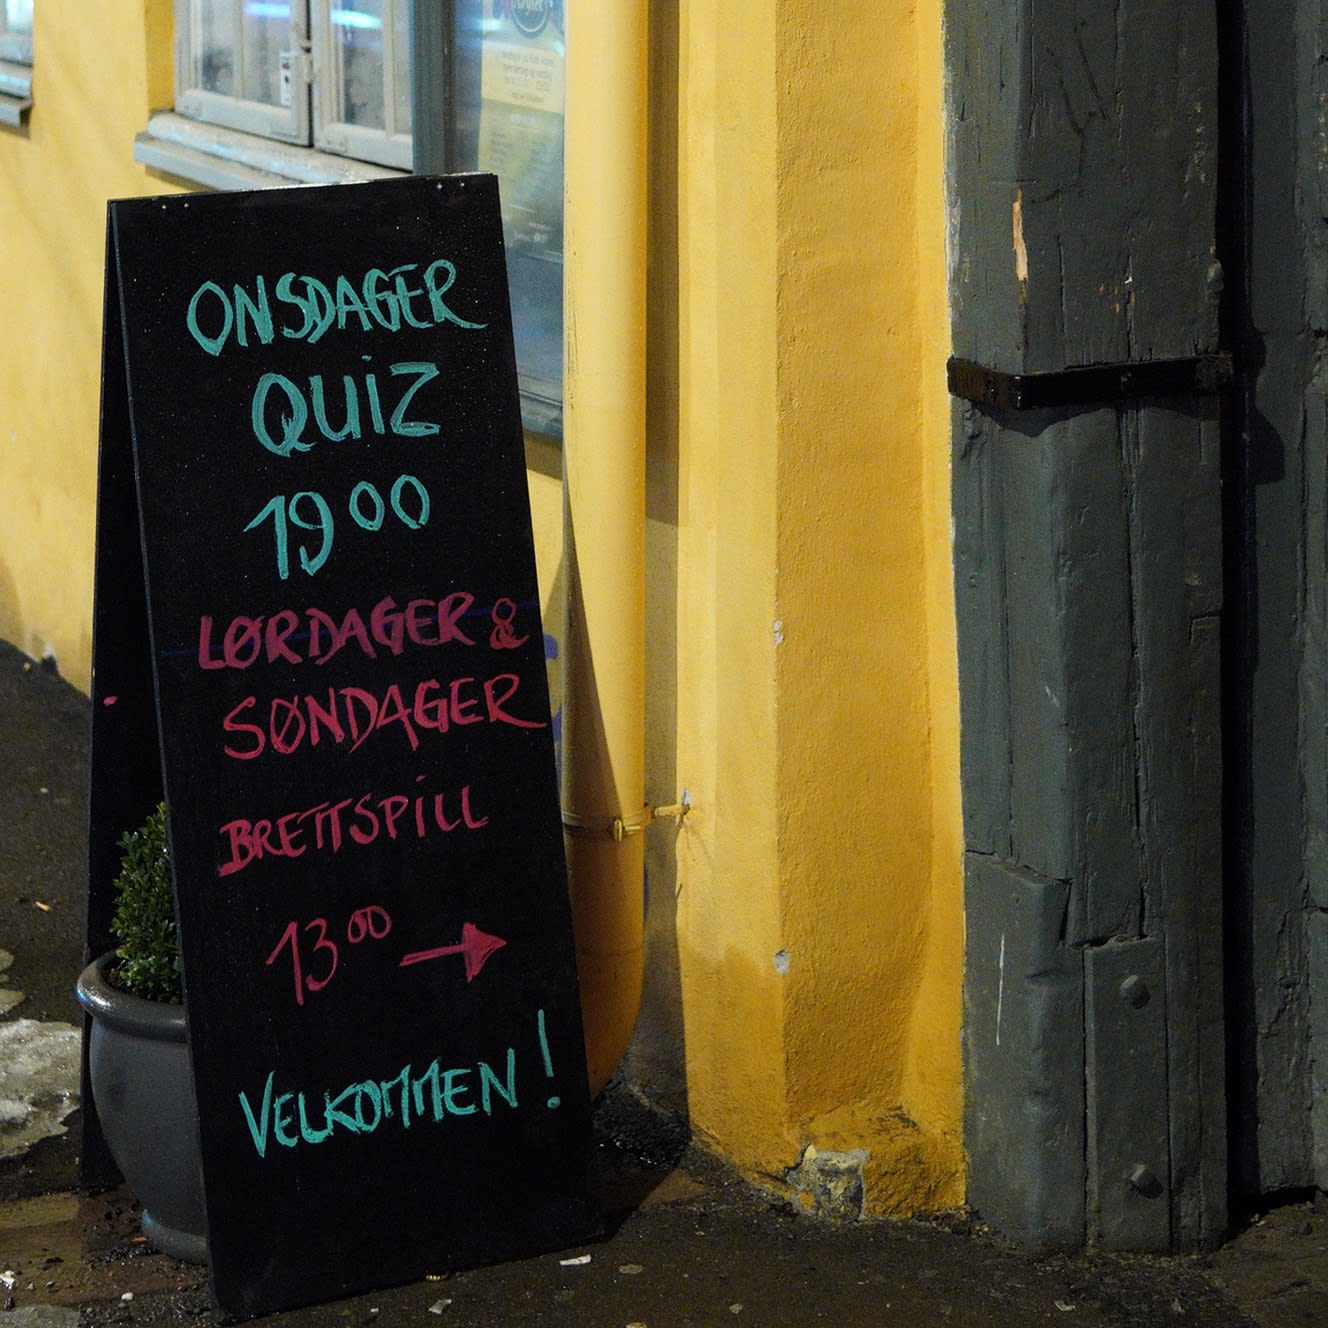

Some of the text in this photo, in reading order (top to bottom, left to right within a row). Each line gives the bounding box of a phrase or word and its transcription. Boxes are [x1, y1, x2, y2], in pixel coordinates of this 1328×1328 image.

[186, 259, 488, 357] ONSDAGER
[198, 591, 531, 671] LØRDAGER &
[223, 673, 547, 760] SØNDAGER
